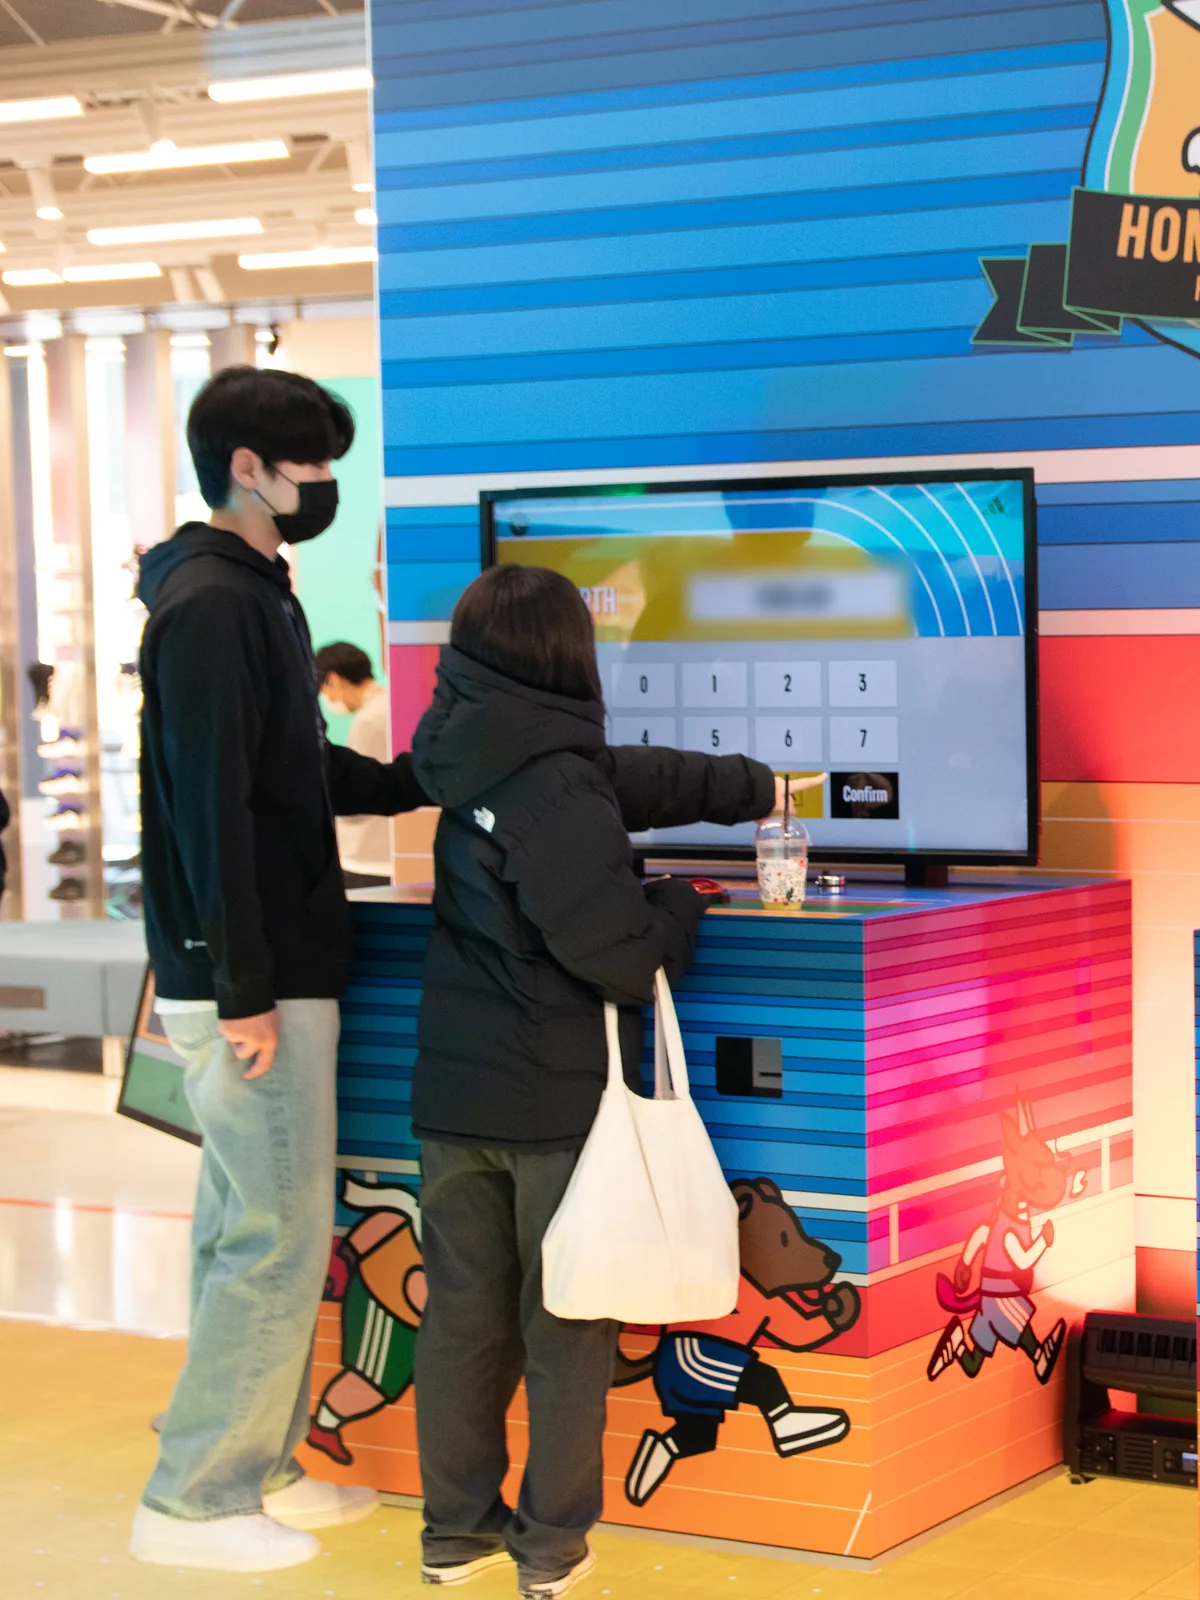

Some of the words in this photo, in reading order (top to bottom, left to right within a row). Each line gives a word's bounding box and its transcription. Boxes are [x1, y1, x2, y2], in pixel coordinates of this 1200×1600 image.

[639, 674, 649, 694] 0
[711, 674, 718, 693] 1
[783, 673, 793, 693] 2
[858, 673, 868, 692] 3
[640, 728, 650, 747] 4
[710, 728, 720, 748] 5
[784, 729, 794, 749] 6
[858, 728, 868, 748] 7
[842, 784, 888, 803] Confirm
